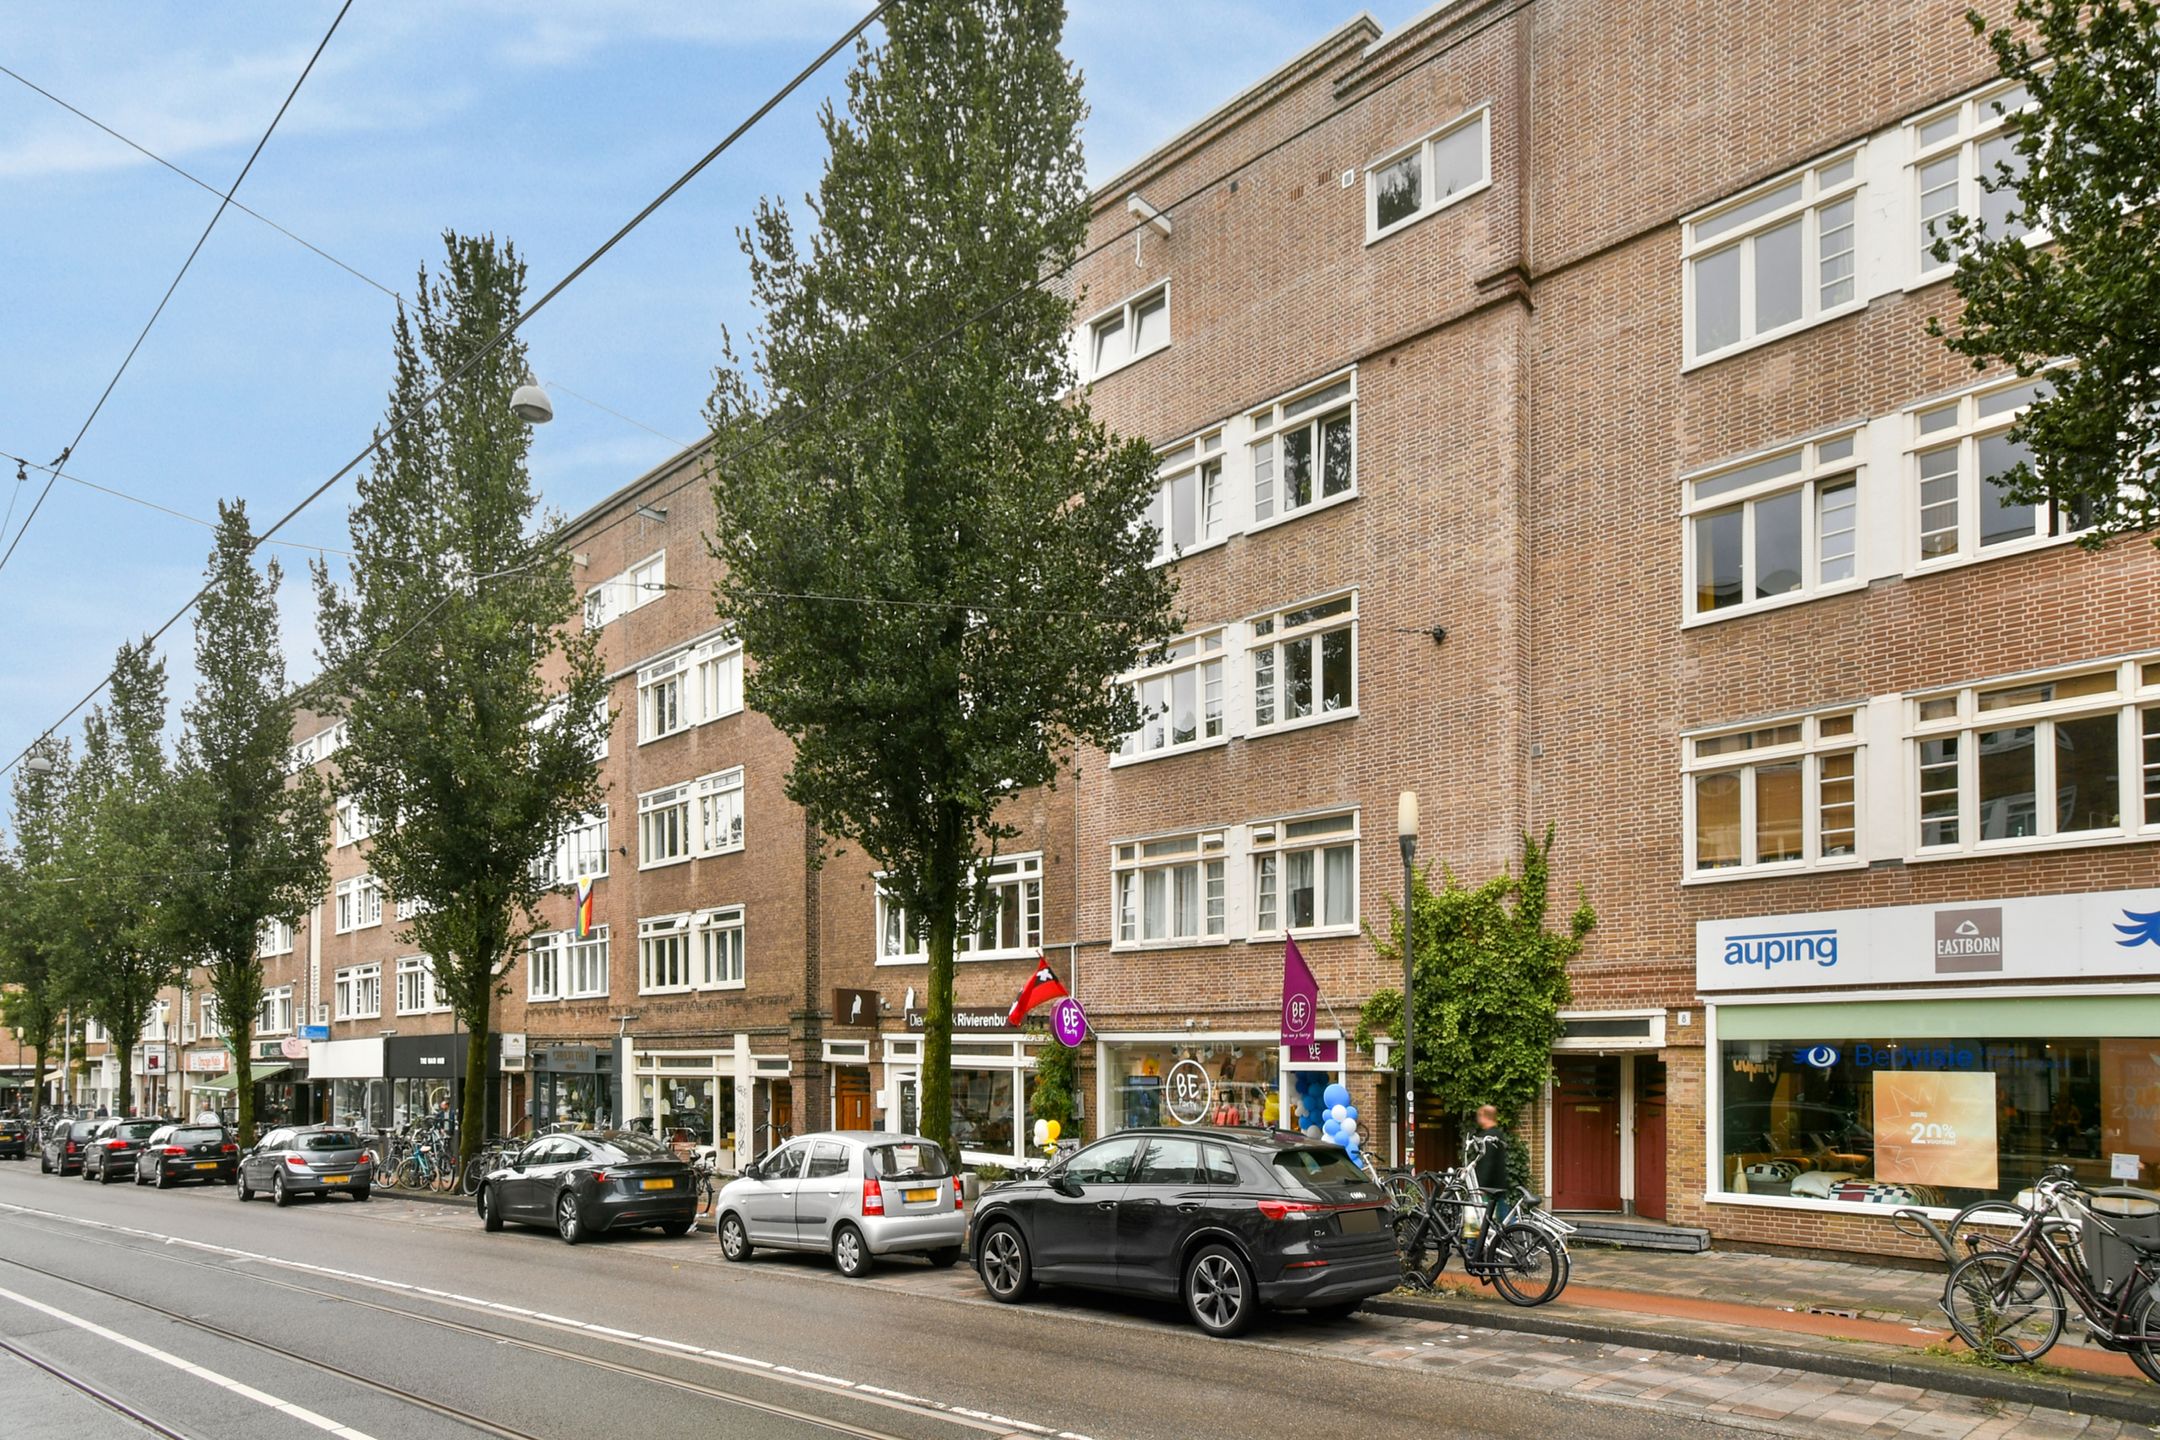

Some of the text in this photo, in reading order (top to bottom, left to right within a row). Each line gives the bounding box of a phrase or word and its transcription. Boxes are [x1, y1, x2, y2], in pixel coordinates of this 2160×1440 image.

[1724, 936, 1837, 969] auping
[1937, 936, 2000, 955] EASTBORN
[1062, 1007, 1079, 1027] BE
[1292, 1001, 1305, 1018] BE
[1681, 1014, 1687, 1023] 8
[957, 1012, 1009, 1026] Rivierenbu
[1064, 1027, 1077, 1037] Party
[1309, 1043, 1321, 1055] BE
[1855, 1044, 1973, 1068] Bedvisie
[1176, 1073, 1199, 1098] BE
[1178, 1098, 1197, 1110] Party
[1911, 1122, 1956, 1144] 20%
